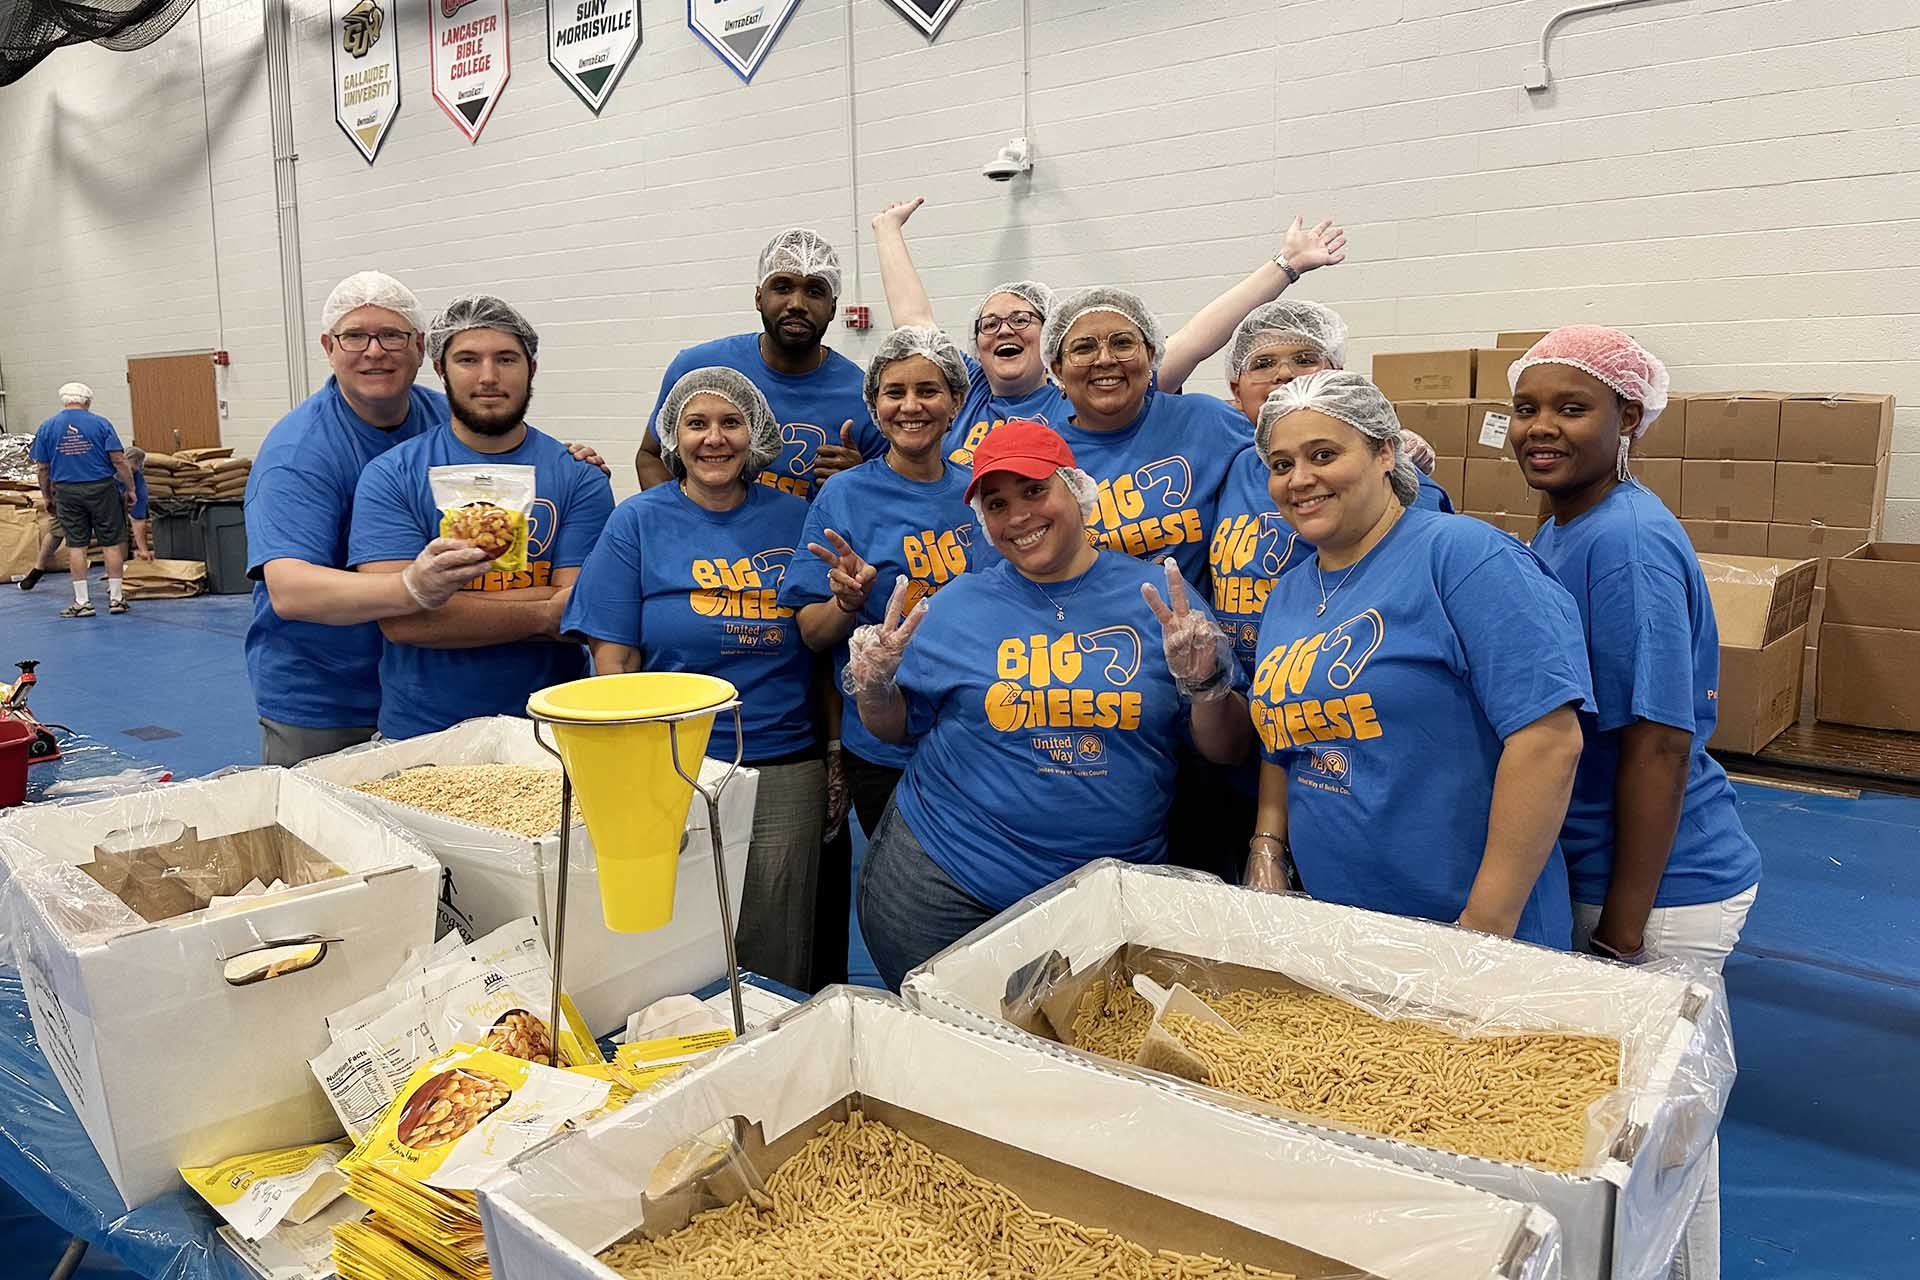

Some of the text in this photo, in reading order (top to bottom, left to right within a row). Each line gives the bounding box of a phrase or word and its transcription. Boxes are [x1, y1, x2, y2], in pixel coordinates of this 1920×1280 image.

[576, 0, 608, 21] SUNY
[441, 15, 497, 47] LANCASTER
[556, 9, 632, 48] MORRISVILLE
[456, 37, 483, 60] BIBLE
[344, 63, 390, 90] GALLAUDET
[450, 54, 492, 81] COLLEGE
[343, 79, 392, 107] UNIVERSITY
[725, 623, 760, 635] United
[737, 634, 759, 648] Way
[984, 680, 1143, 733] CHEESE
[1250, 692, 1384, 754] CHEESE
[1032, 736, 1074, 750] United
[1048, 749, 1074, 764] Way
[1311, 752, 1328, 775] Way
[325, 1049, 368, 1083] Nutrition Facts
